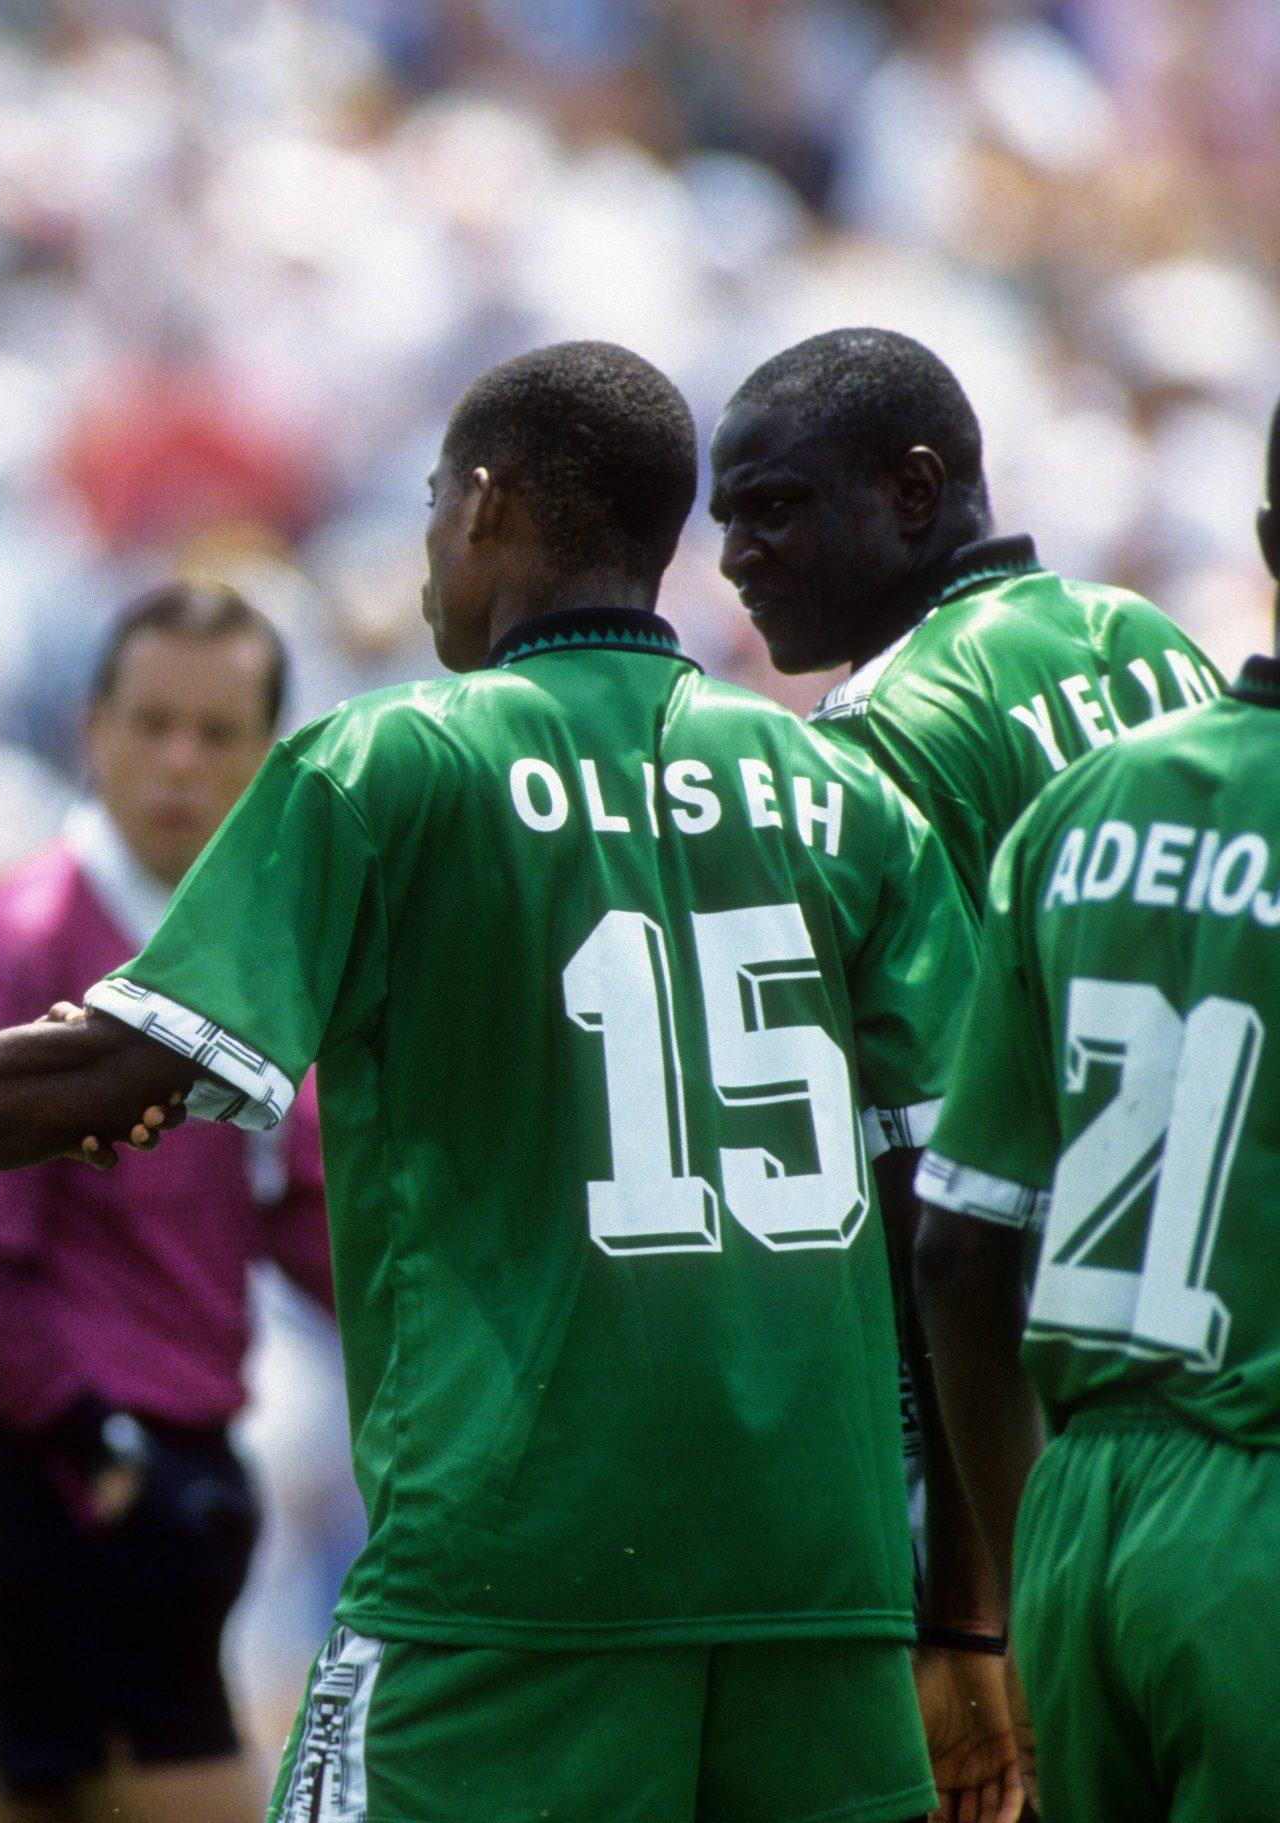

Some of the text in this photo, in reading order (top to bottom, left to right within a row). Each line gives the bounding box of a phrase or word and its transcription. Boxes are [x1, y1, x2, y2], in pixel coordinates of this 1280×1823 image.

[509, 758, 844, 857] OLISEH
[562, 903, 870, 1256] 15
[1023, 977, 1266, 1372] 21
